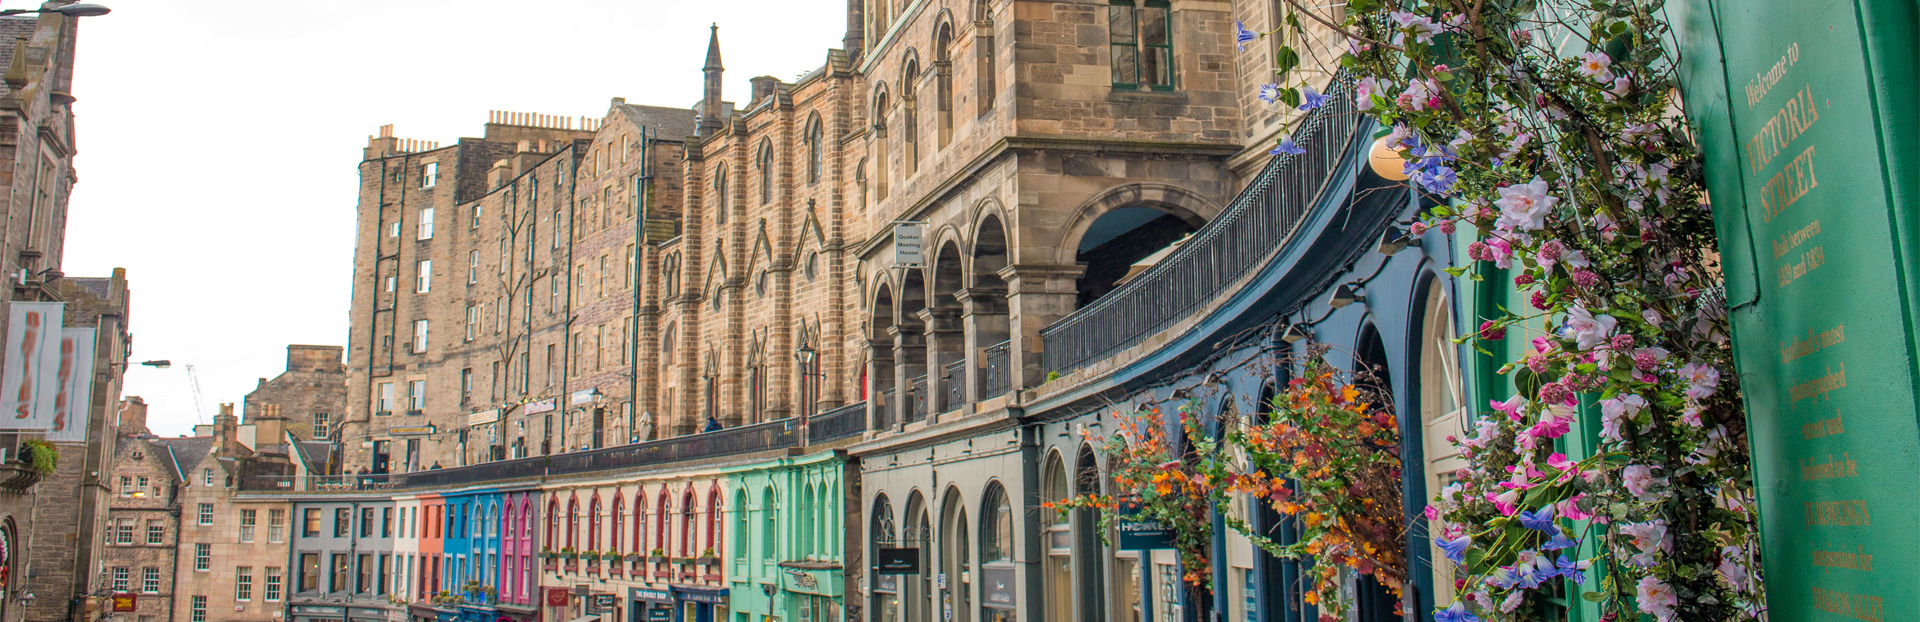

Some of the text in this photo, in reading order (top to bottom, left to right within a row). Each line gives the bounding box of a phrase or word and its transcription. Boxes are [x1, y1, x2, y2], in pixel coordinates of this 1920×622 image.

[1745, 42, 1799, 110] Welcome to
[1745, 82, 1819, 176] VICTORIA
[1760, 145, 1818, 223] STREET
[1788, 219, 1821, 249] between
[1793, 254, 1807, 280] and
[1820, 322, 1845, 349] most
[1789, 361, 1846, 410] photographed
[1802, 407, 1844, 440] street and
[1800, 452, 1858, 481] believed to be
[1803, 502, 1815, 531] JK
[1810, 541, 1873, 574] inspiration for
[1811, 587, 1884, 622] DIAGON ALLEY
